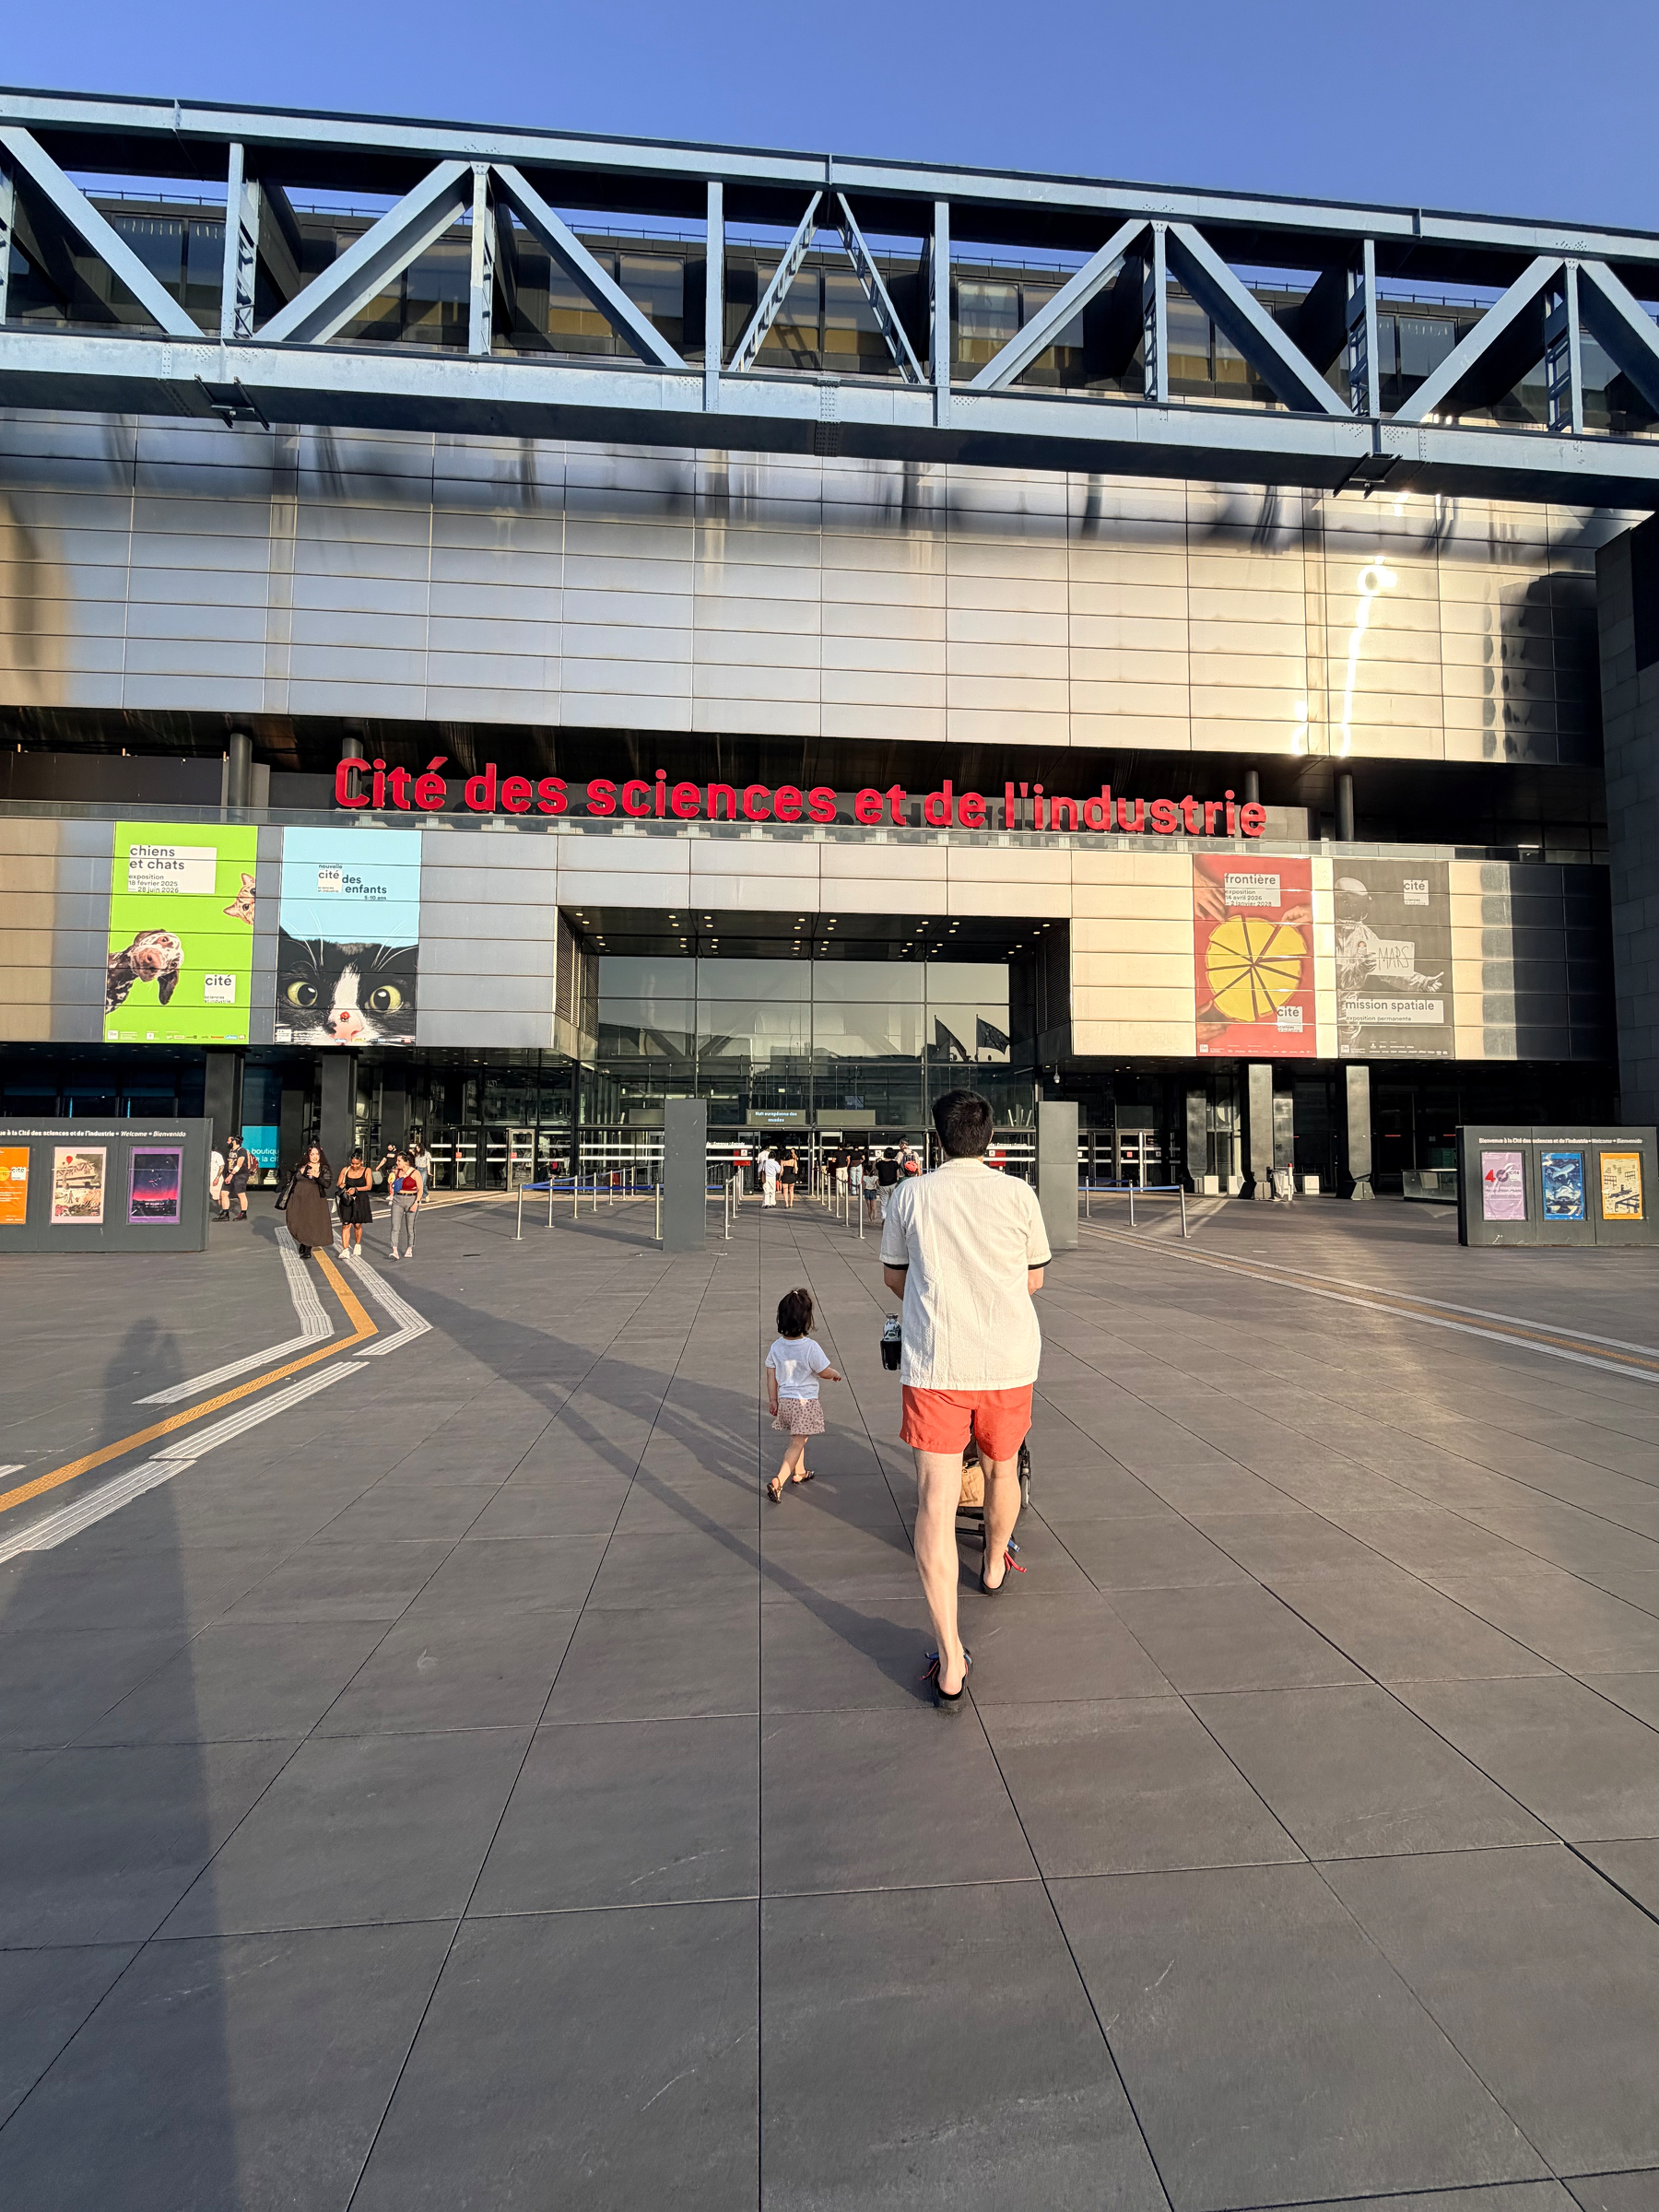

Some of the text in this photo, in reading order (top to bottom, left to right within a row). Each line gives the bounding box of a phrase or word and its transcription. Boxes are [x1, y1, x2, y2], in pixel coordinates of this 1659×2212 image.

[335, 757, 1266, 837] Cité des sciences et de l'industrie
[130, 845, 175, 857] chiens
[129, 859, 185, 870] et chats
[318, 870, 340, 879] cité
[342, 875, 361, 884] des
[1225, 873, 1276, 885] frontière
[345, 884, 387, 894] enfants
[1404, 880, 1425, 890] cité
[1378, 946, 1409, 971] MARS
[206, 974, 231, 986] cité
[1346, 999, 1434, 1012] mission spatiale
[1277, 1006, 1300, 1018] cité
